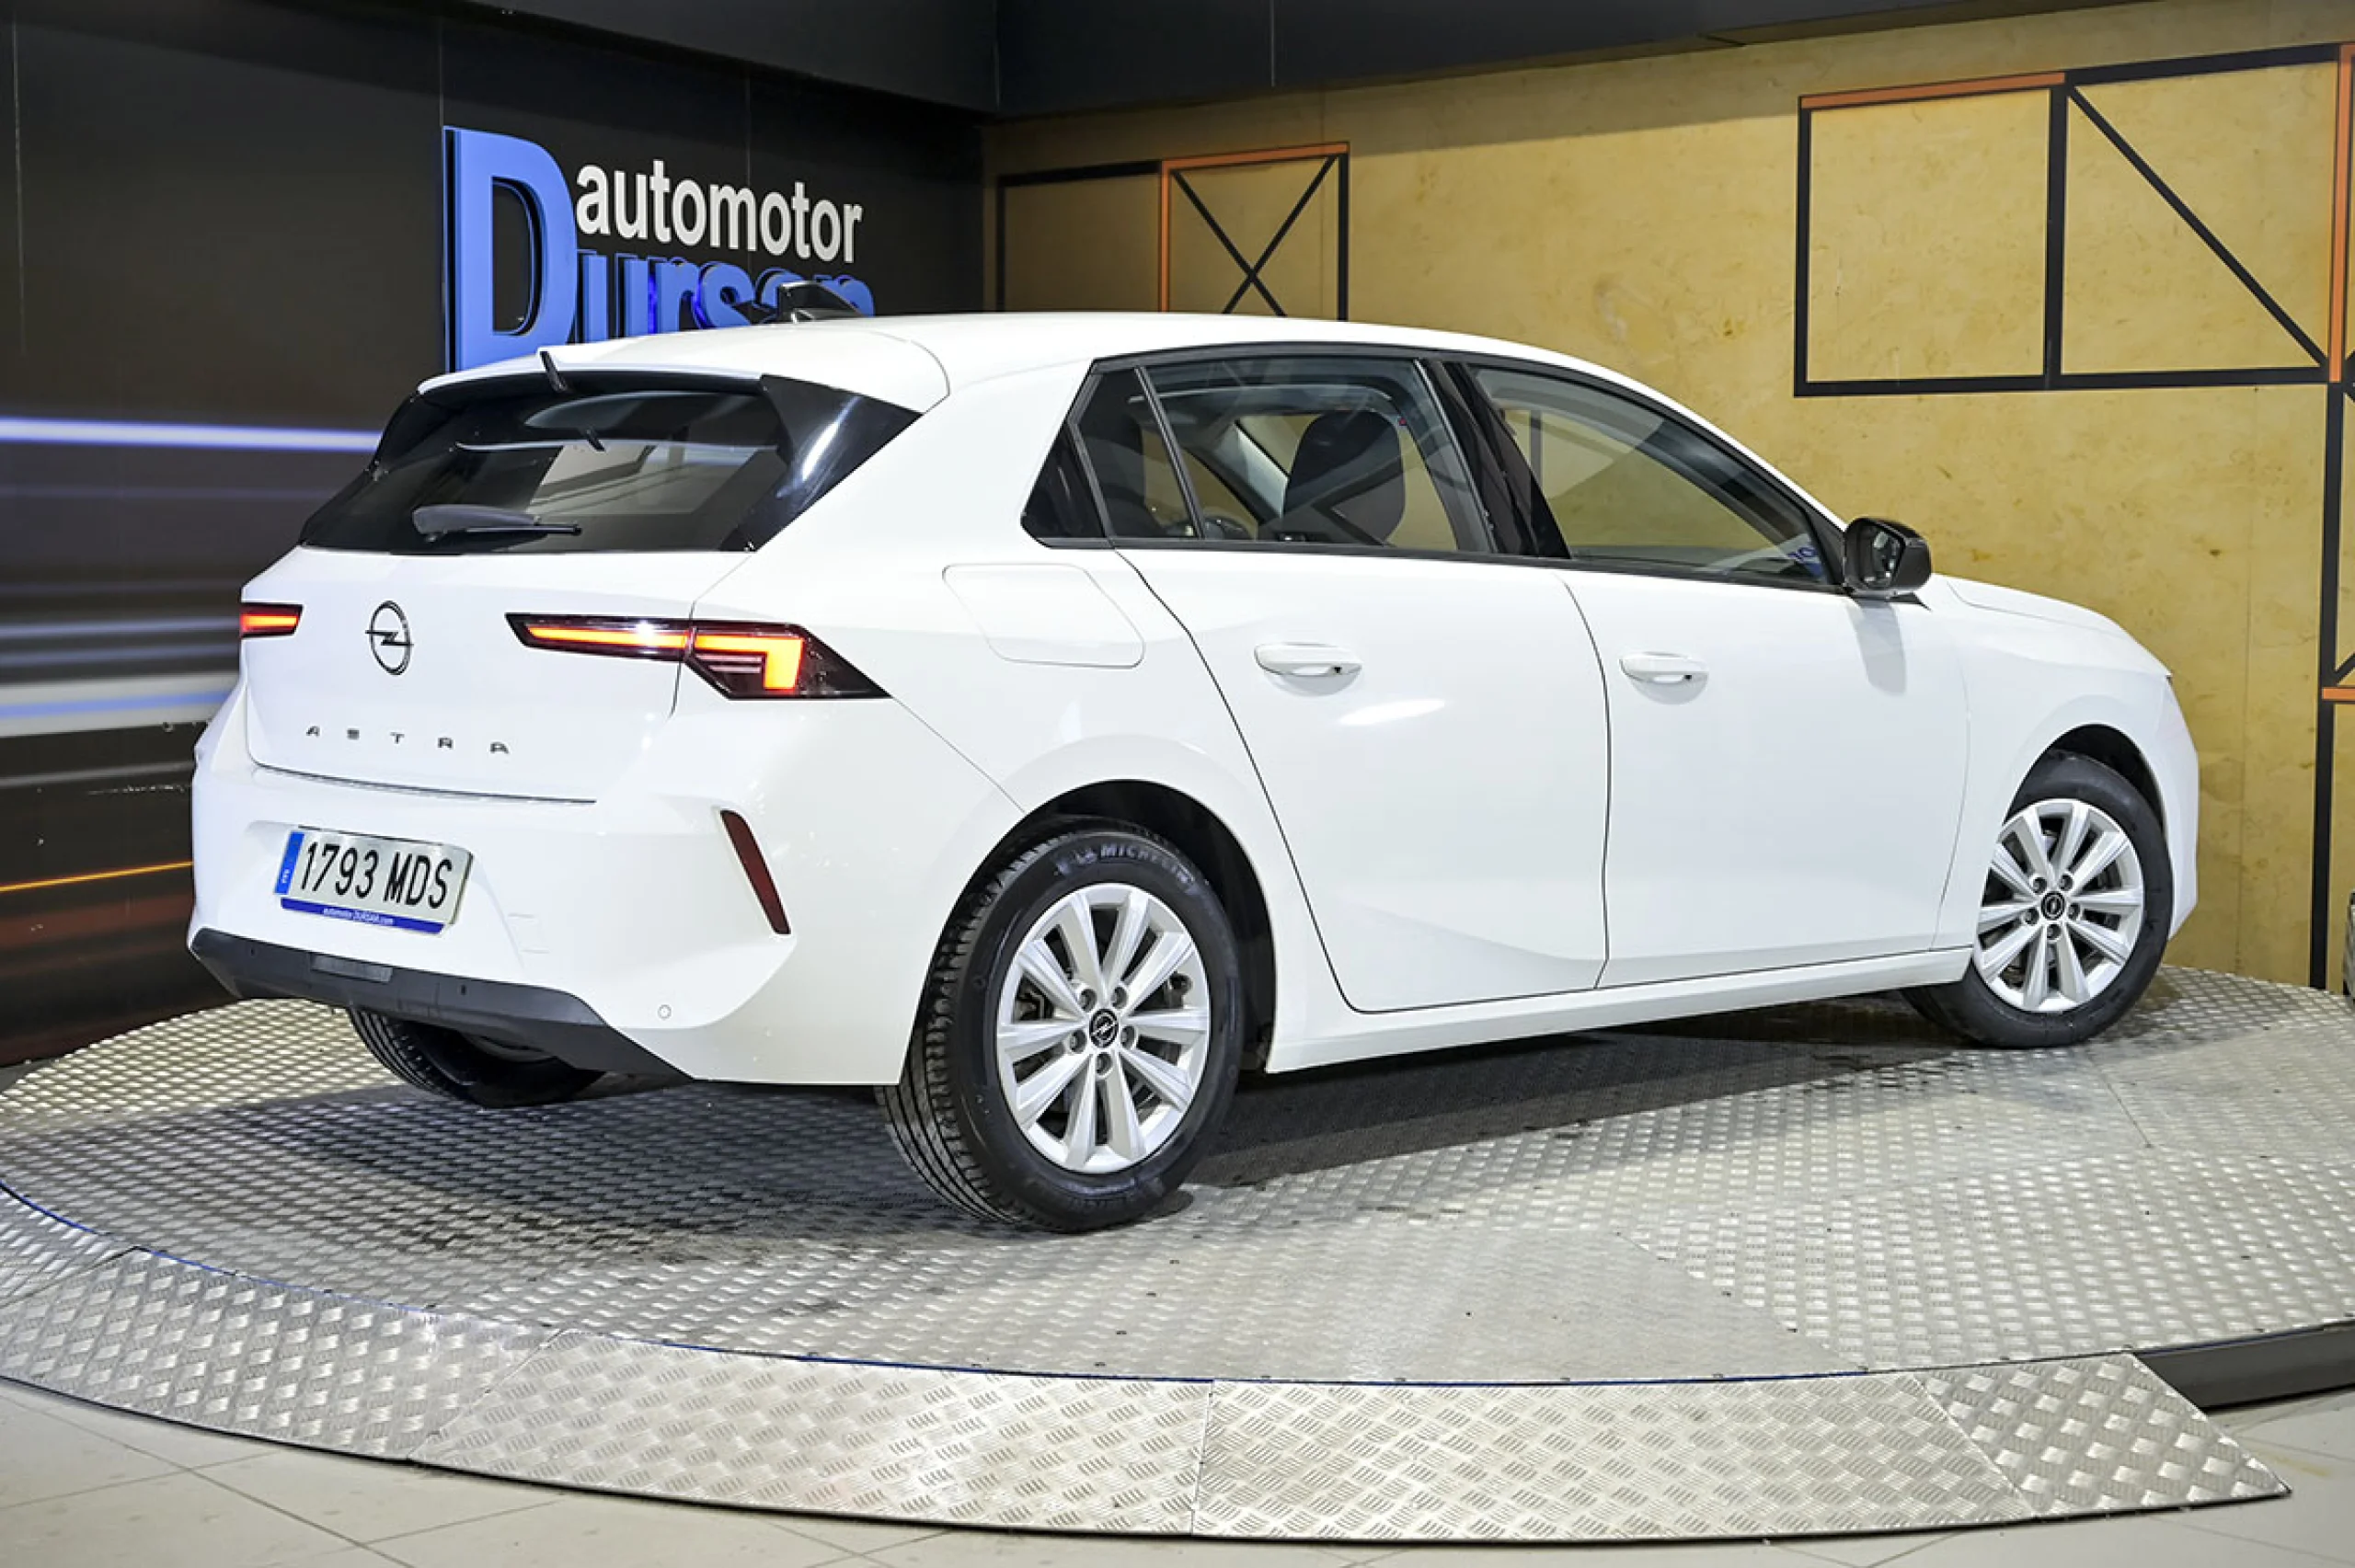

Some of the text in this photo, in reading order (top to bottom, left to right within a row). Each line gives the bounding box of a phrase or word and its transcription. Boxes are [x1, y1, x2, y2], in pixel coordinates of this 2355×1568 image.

[577, 159, 863, 263] automotor
[305, 725, 510, 755] ASTRA
[301, 841, 453, 910] 1793 MDS
